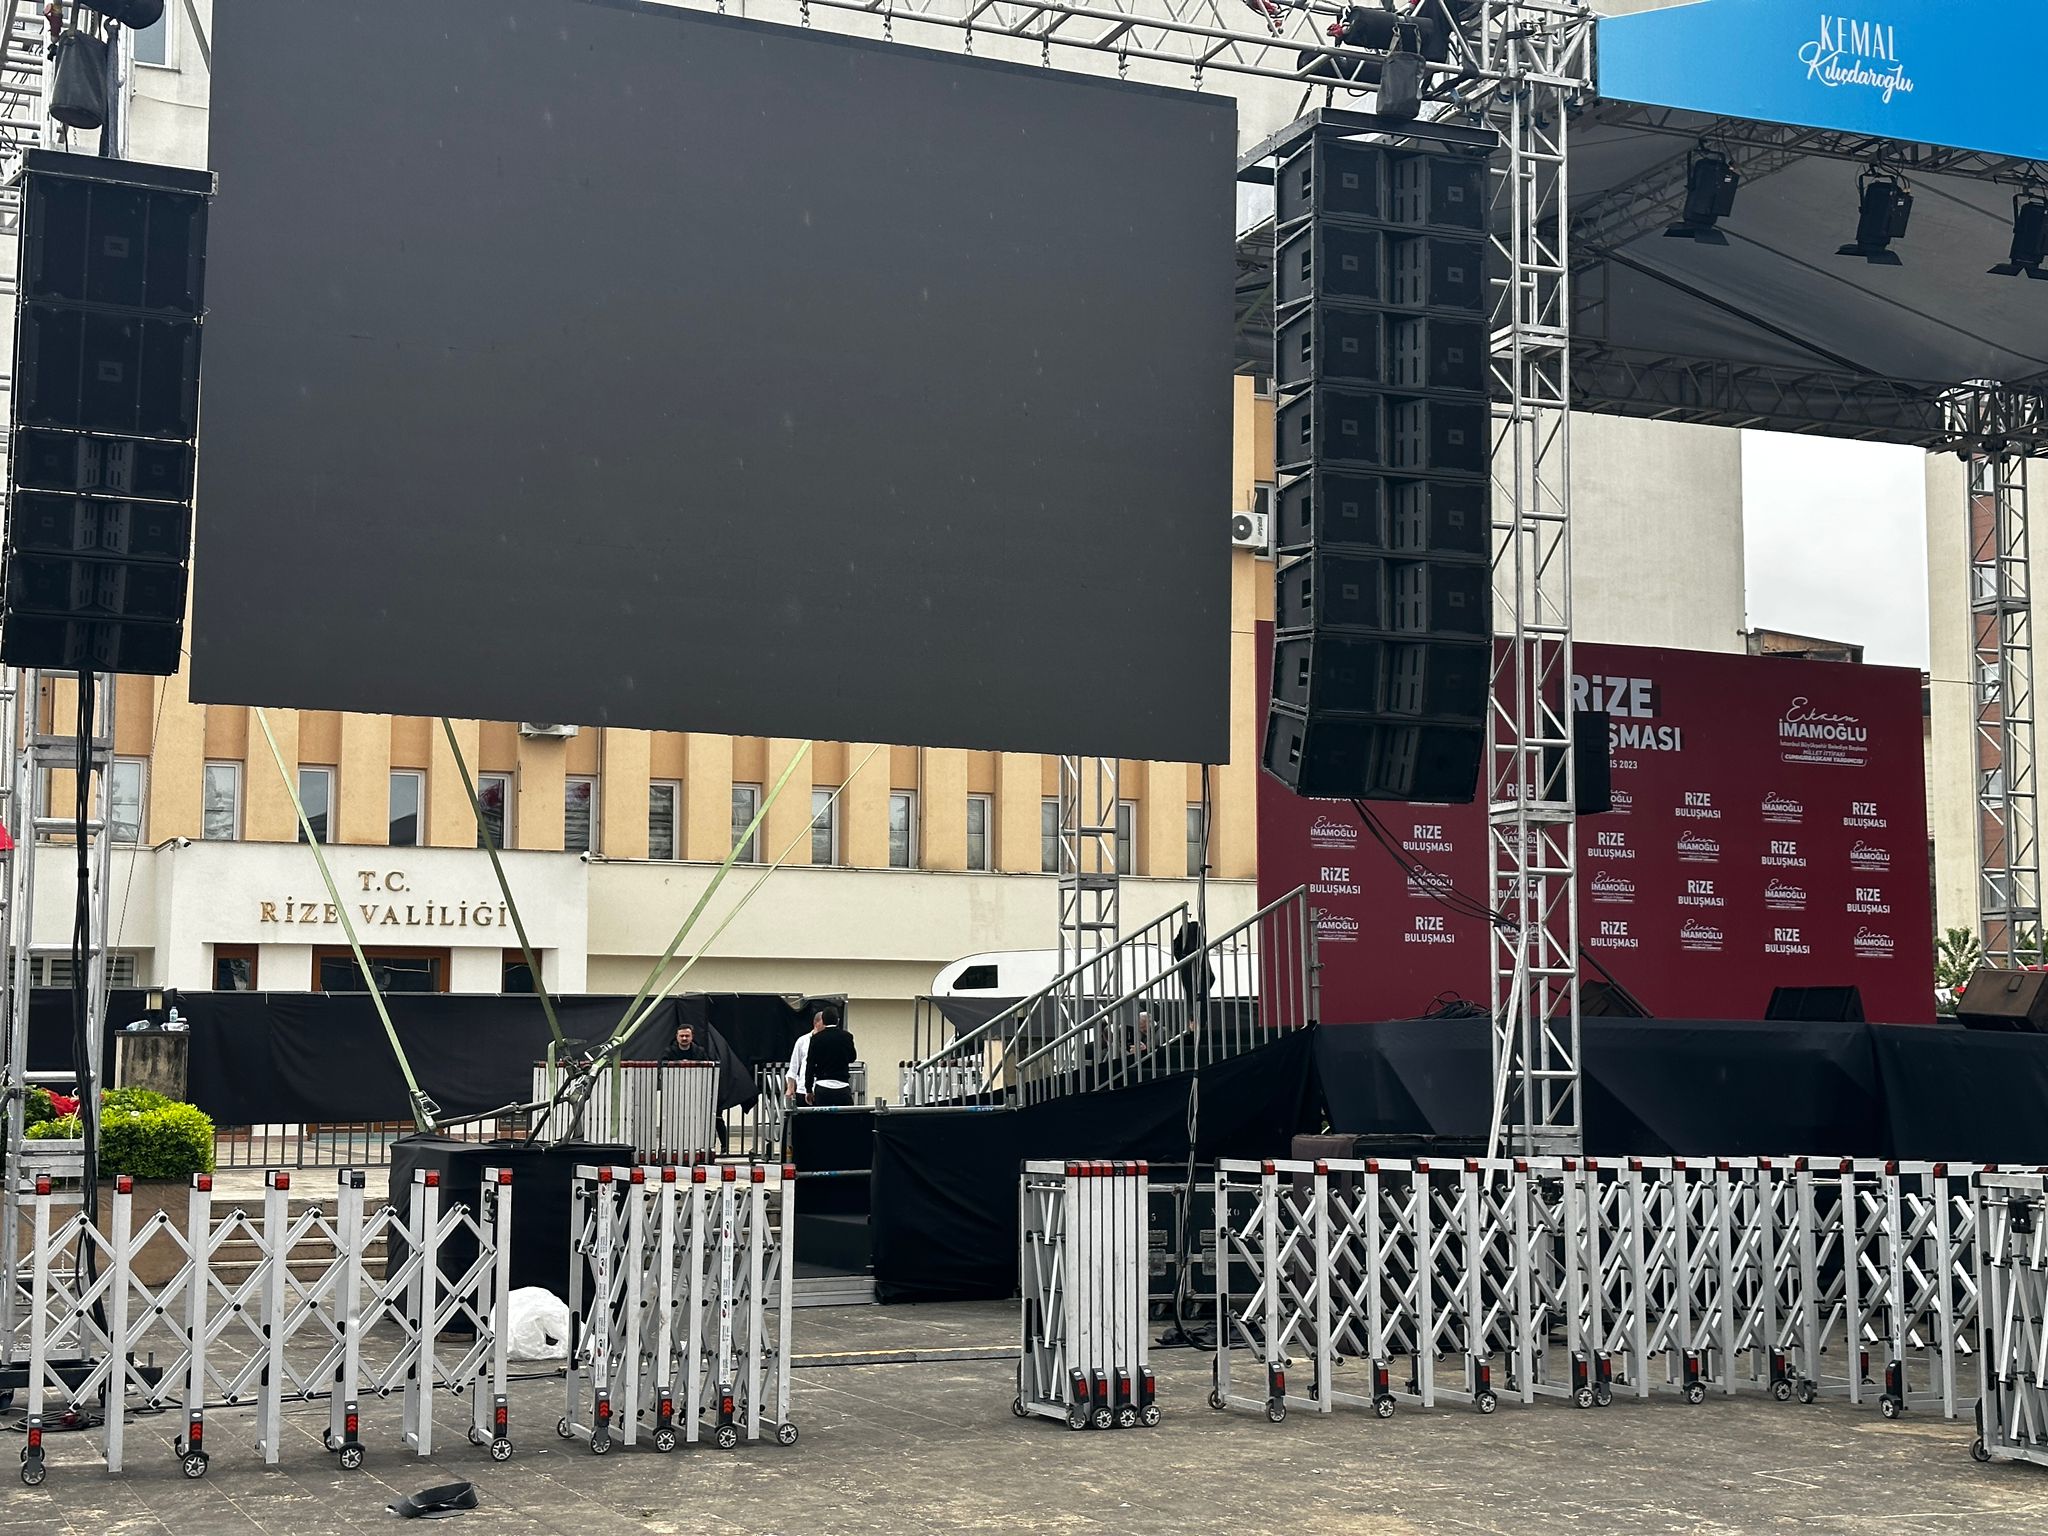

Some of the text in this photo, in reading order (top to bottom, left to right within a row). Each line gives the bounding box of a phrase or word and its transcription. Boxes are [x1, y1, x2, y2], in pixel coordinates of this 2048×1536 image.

[1820, 14, 1899, 62] KEMAL
[1779, 719, 1867, 742] İMAMOĞLU
[1619, 760, 1638, 769] 2023
[1675, 808, 1721, 819] BULUŞMASI
[1843, 817, 1887, 829] BULUŞMASI
[1403, 841, 1453, 853] BULUŞMASI
[1588, 848, 1635, 860] BULUŞMASI
[1761, 856, 1807, 868] BULUŞMASI
[358, 871, 411, 892] T.C.
[1310, 884, 1361, 895] BULUŞMASI
[1678, 896, 1724, 908] BULUŞMASI
[260, 896, 507, 927] RİZE VALİLİĞİ
[1847, 904, 1890, 915] BULUŞMASI
[1317, 921, 1359, 930] MAMOĞLU
[1405, 933, 1455, 944] BULUŞMASI
[1591, 937, 1638, 949] BULUŞMASI
[1765, 944, 1810, 955] BULUŞMASI
